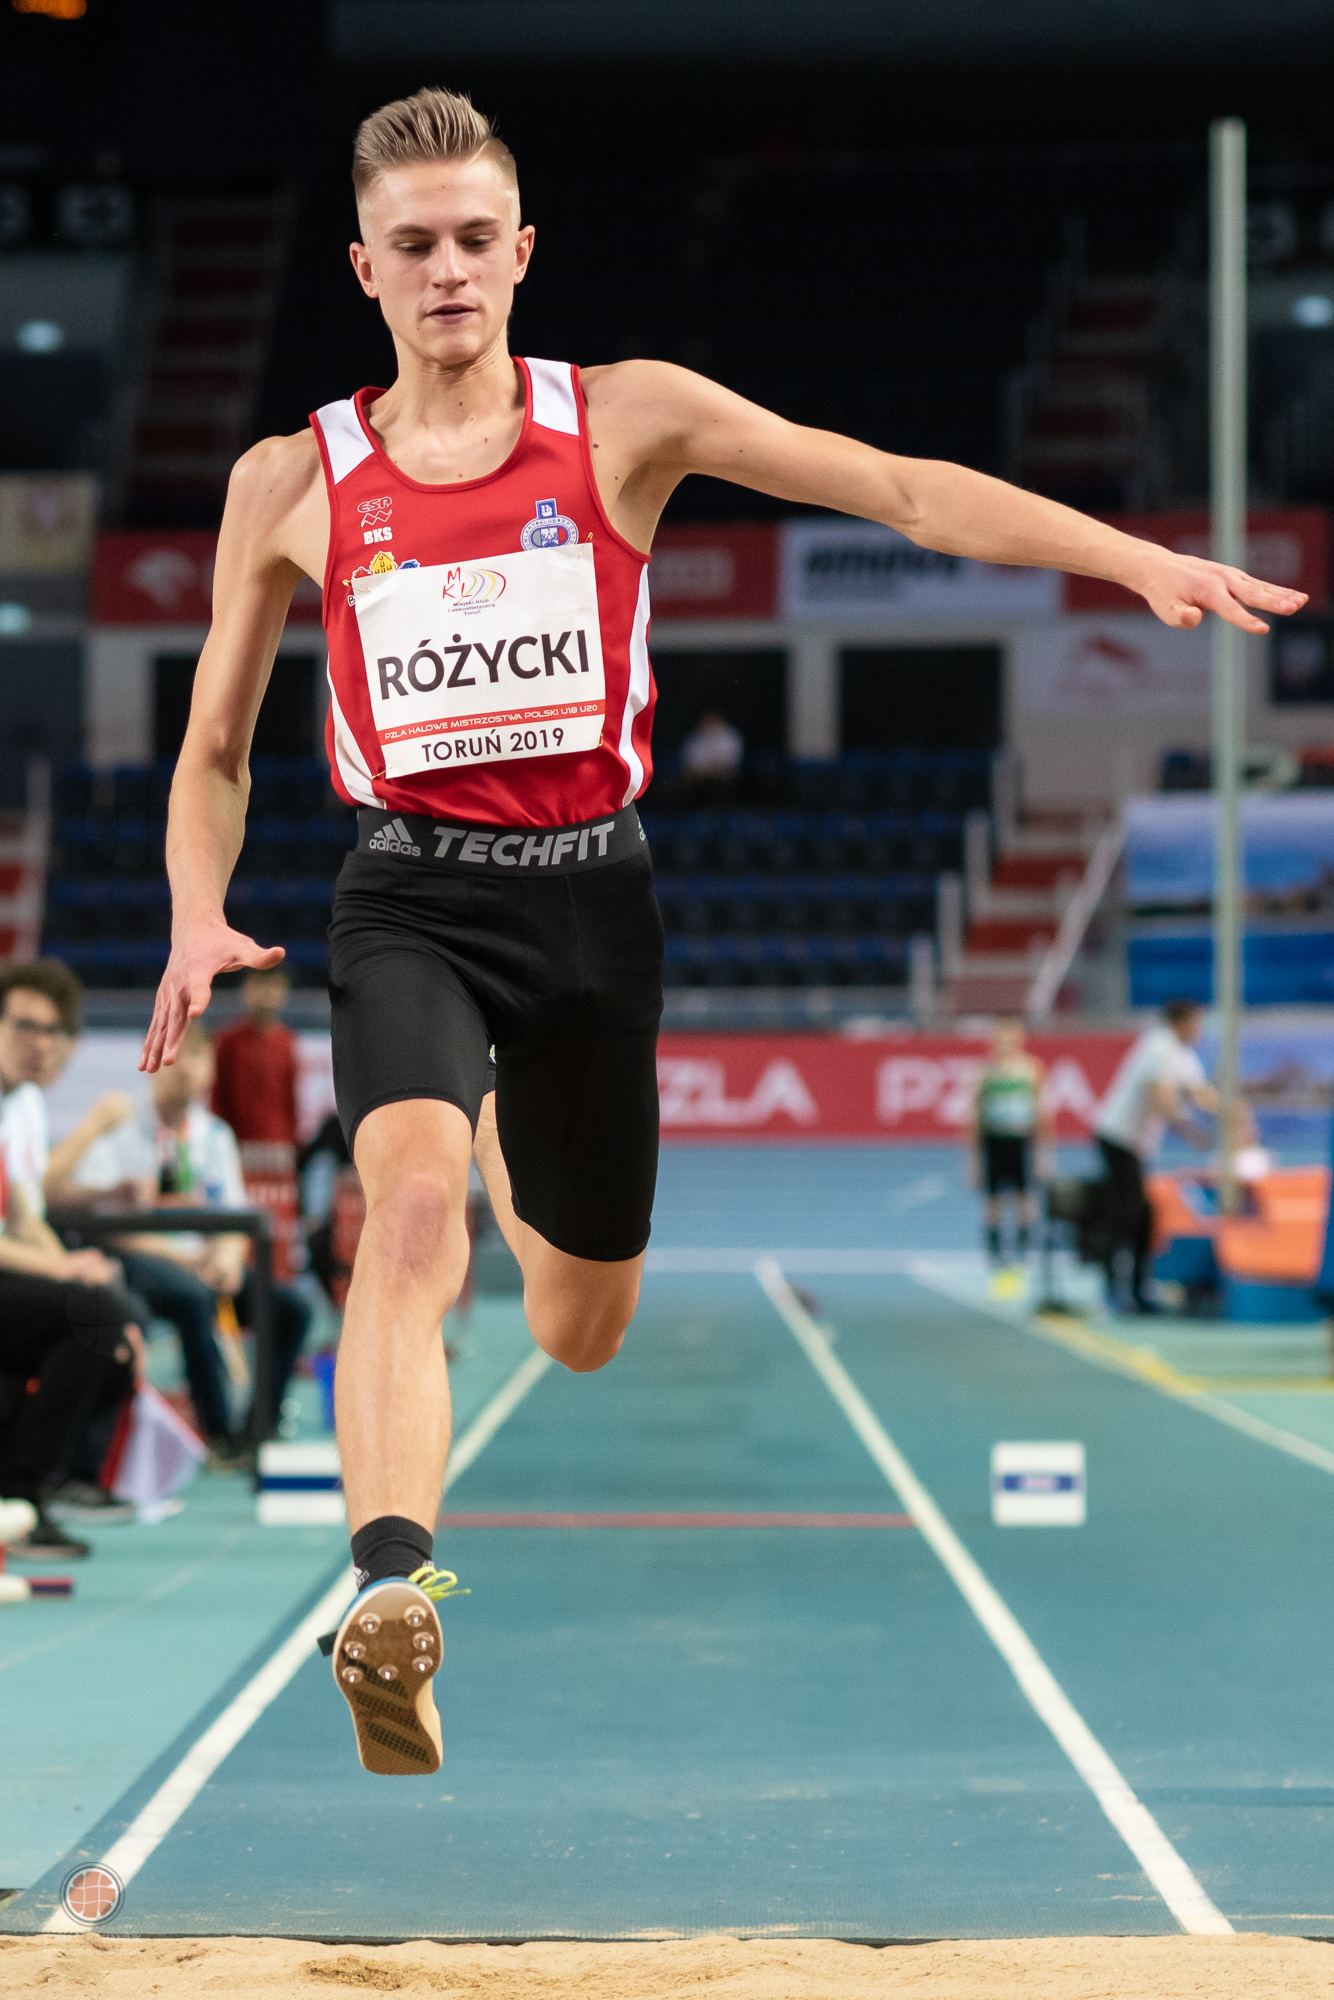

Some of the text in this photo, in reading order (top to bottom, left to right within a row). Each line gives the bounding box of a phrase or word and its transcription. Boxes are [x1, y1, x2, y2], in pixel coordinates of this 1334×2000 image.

[363, 526, 393, 545] BKS
[377, 629, 590, 701] RÓŻYCKI
[384, 704, 598, 741] PZLA HALOWE MISTRZOSTWA POLSKI U18 U20
[421, 727, 565, 763] TORUŃ 2019
[368, 837, 422, 857] adidas
[433, 821, 615, 867] TECHFIT
[657, 1056, 819, 1127] ZLA
